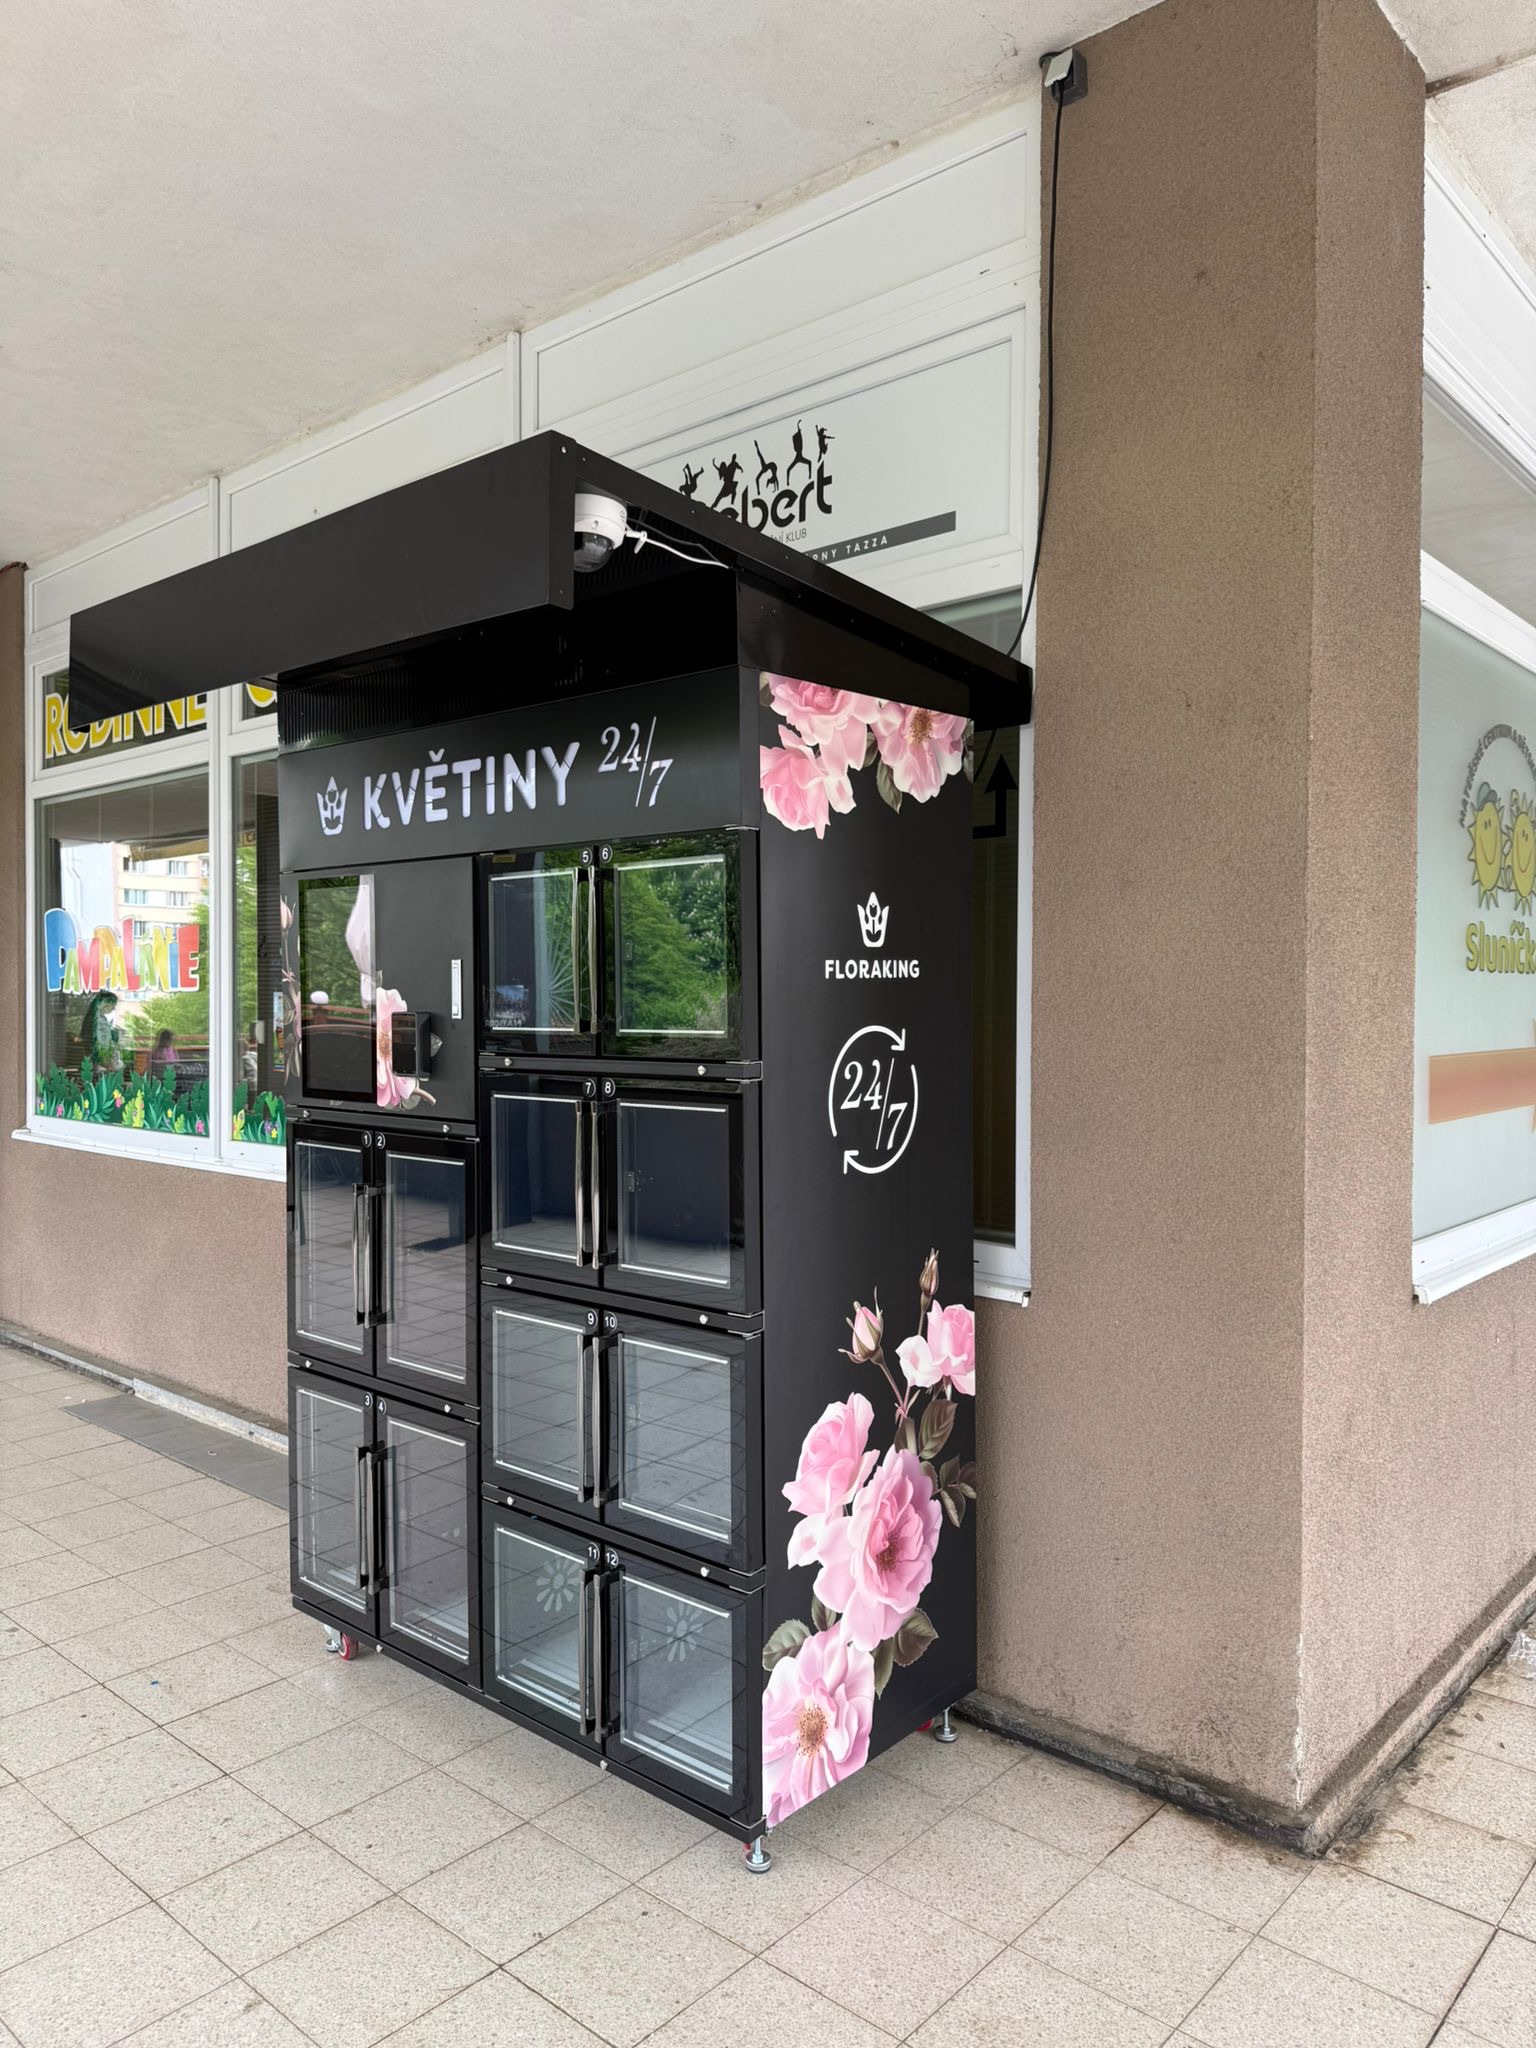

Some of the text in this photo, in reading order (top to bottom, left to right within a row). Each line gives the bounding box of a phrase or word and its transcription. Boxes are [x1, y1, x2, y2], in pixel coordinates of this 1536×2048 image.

[786, 527, 807, 543] KLUB
[846, 535, 888, 554] TAZZA
[363, 716, 674, 831] KVĚTINY 24/7
[825, 959, 920, 979] FLORAKING
[840, 1057, 908, 1150] 24/7
[605, 1315, 615, 1328] 10
[588, 1546, 597, 1559] 11
[605, 1552, 616, 1566] 12
